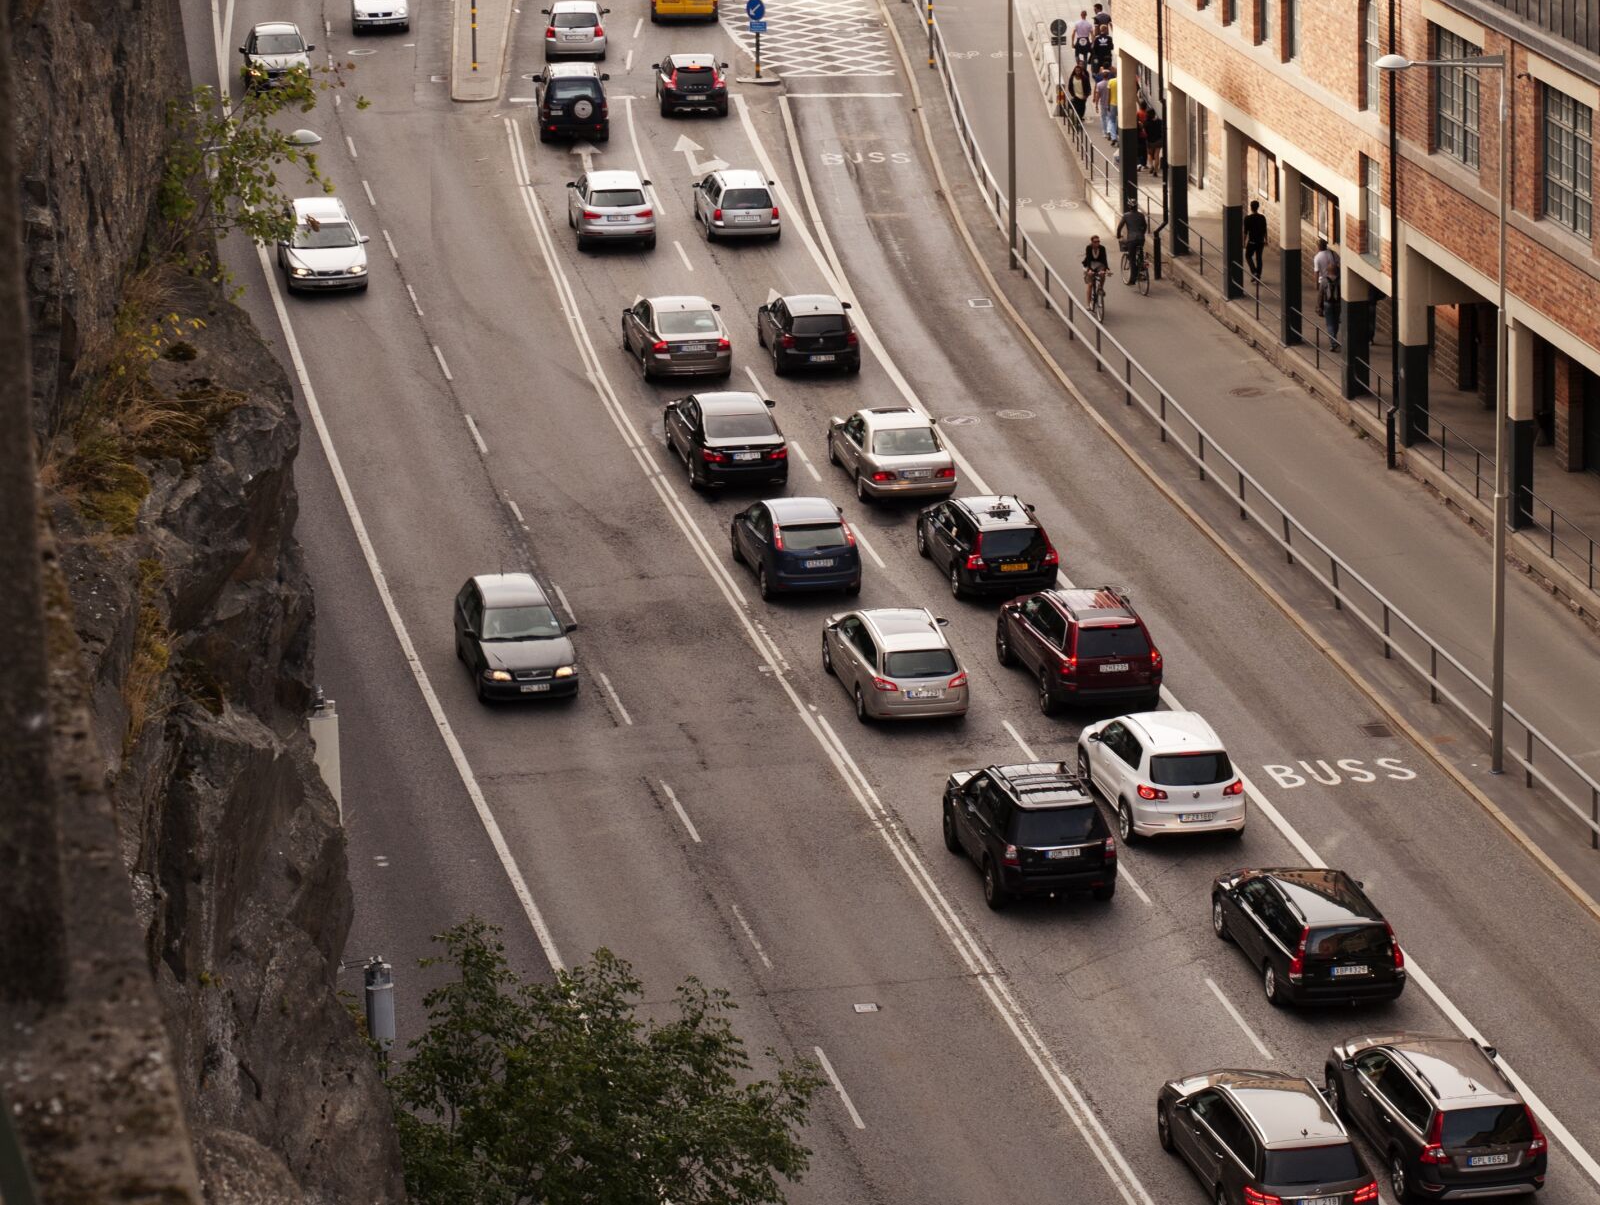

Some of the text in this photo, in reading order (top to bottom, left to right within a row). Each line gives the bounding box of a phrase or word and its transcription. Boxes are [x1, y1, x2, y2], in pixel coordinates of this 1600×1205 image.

[820, 151, 912, 166] BUSS
[1262, 757, 1418, 789] BUSS
[1472, 1155, 1506, 1165] GPL 652
